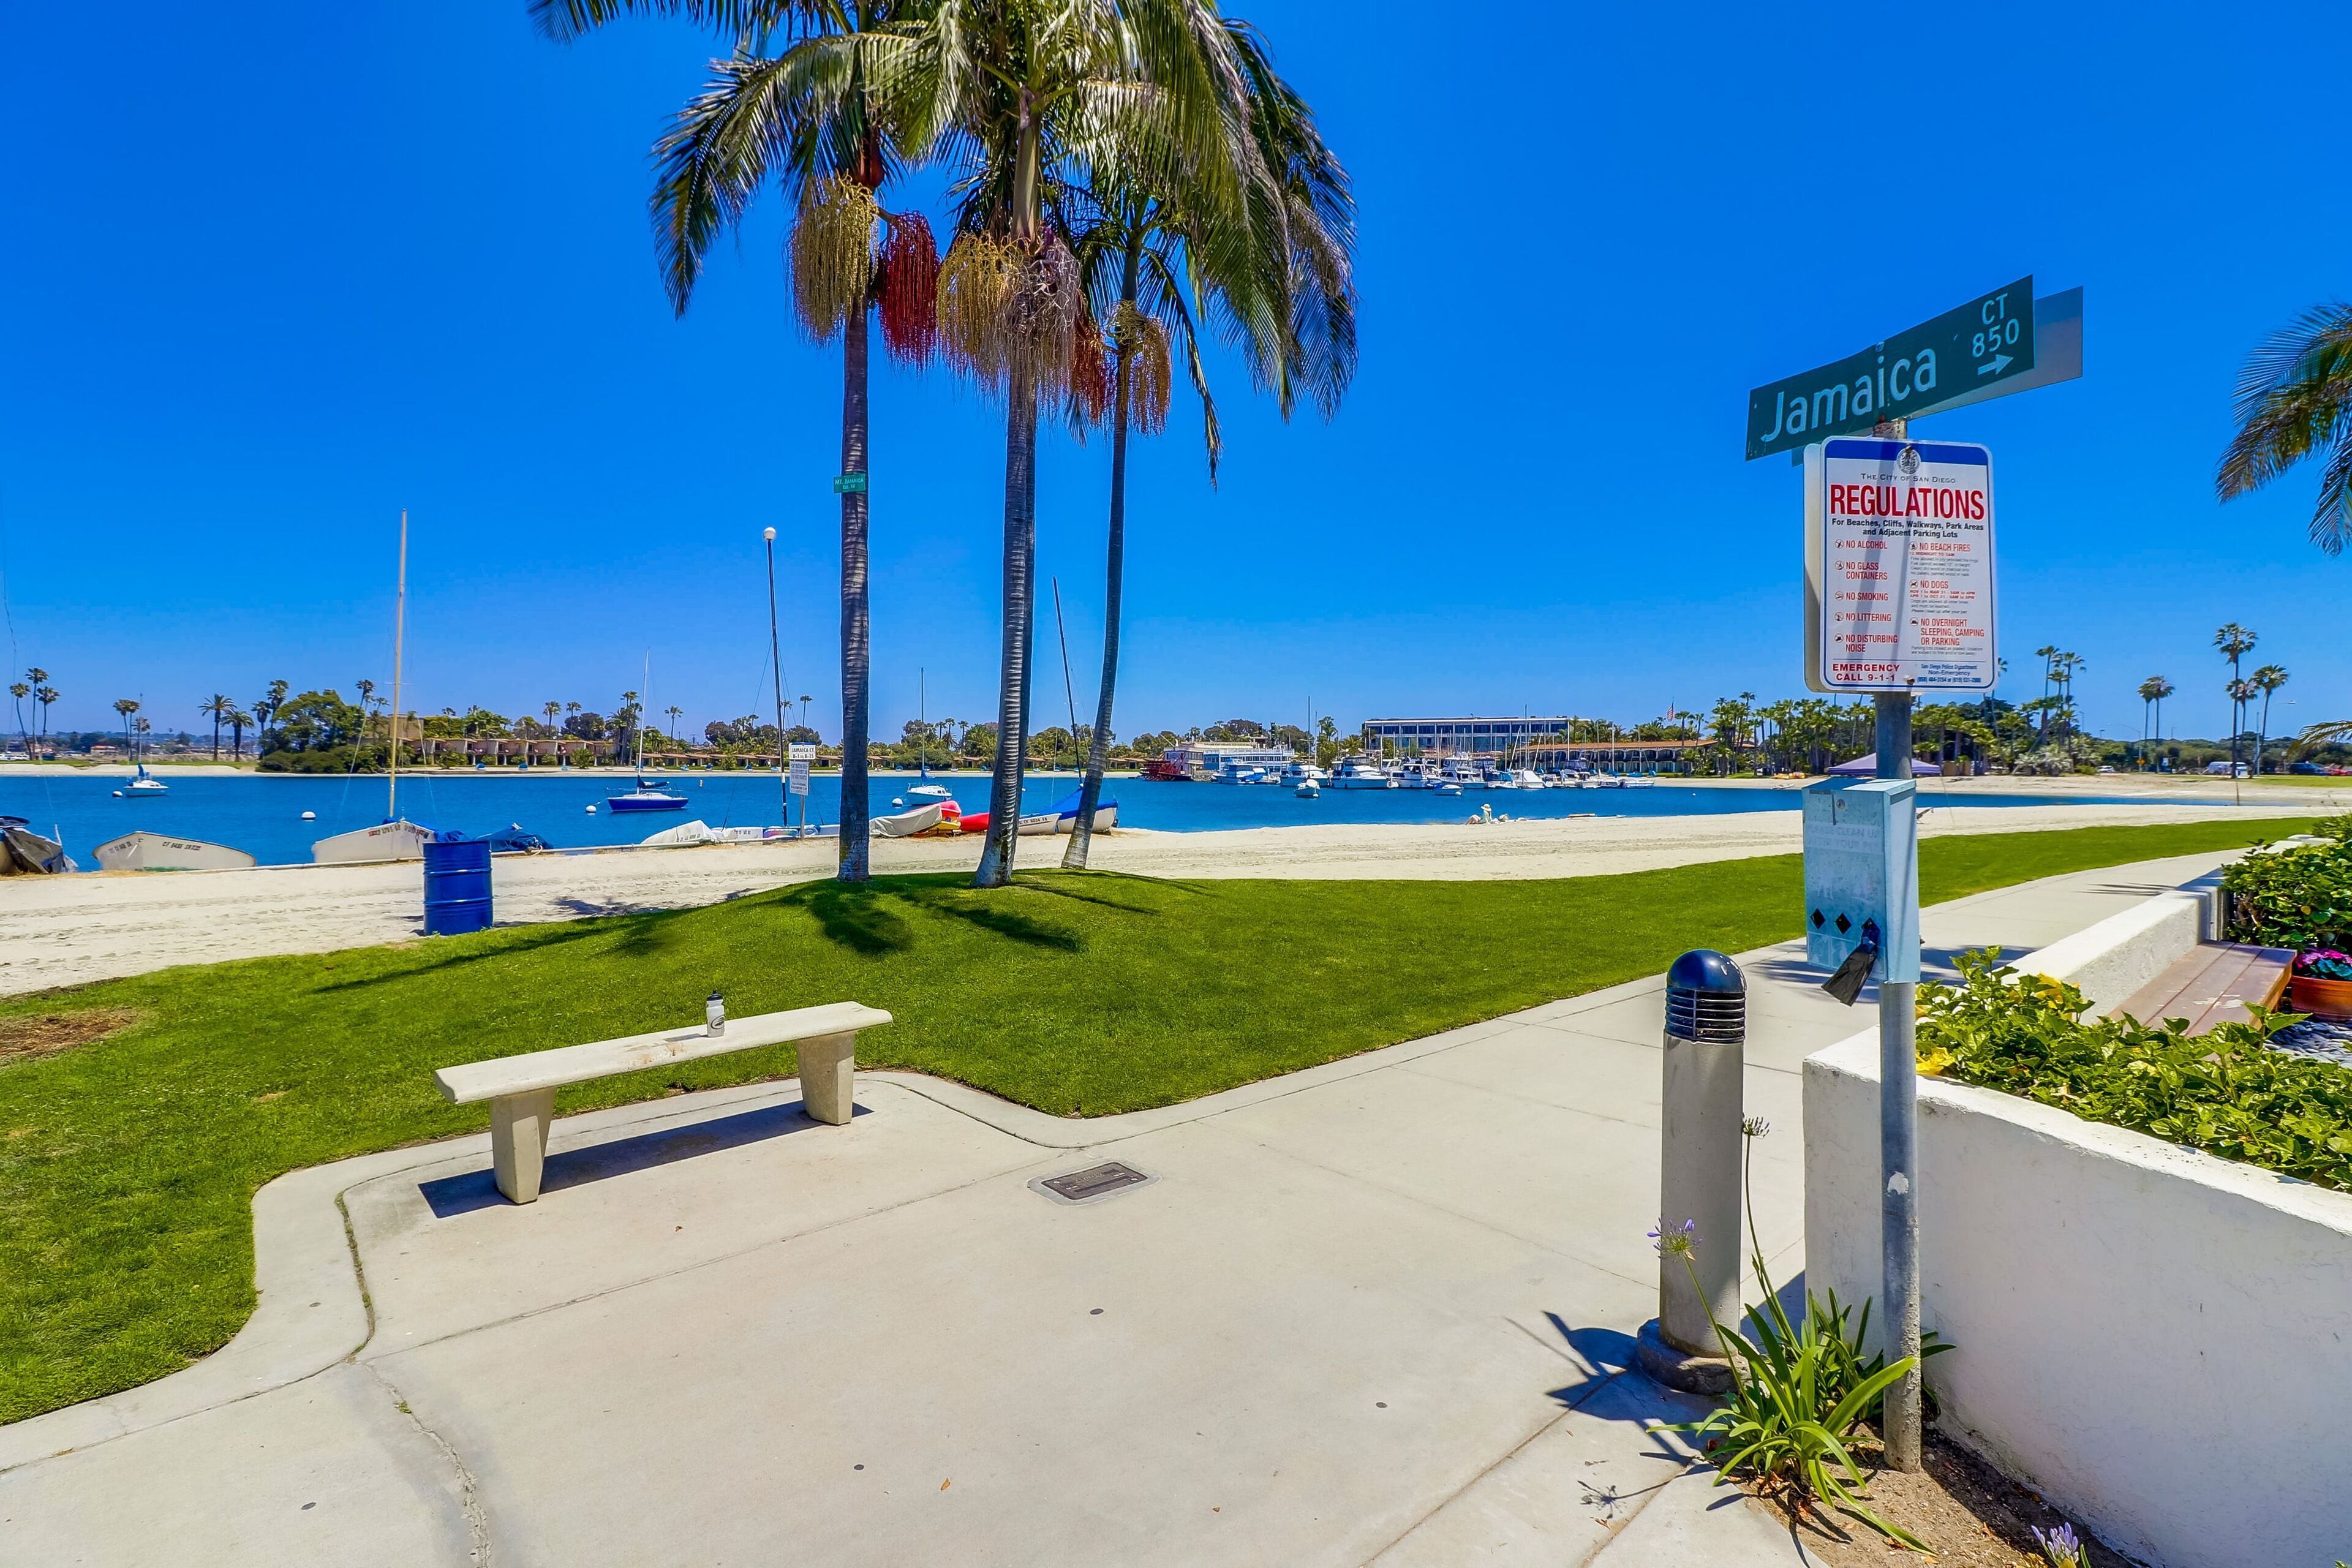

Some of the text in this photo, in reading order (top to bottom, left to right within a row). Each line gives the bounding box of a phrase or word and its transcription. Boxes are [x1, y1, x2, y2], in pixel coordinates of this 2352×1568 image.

[1982, 293, 2008, 325] CT
[1760, 318, 2019, 443] Jamaica 850
[1831, 484, 1985, 520] REGULATIONS
[1847, 519, 1880, 528] Beaches,
[1883, 520, 1904, 528] Cliffs,
[1906, 521, 1943, 530] Walkways,
[1879, 529, 1911, 537] Adjacent
[1913, 530, 1940, 539] Parking
[1857, 541, 1888, 549] ALCOHOL
[1858, 562, 1879, 570] GLASS
[1846, 571, 1888, 580] CONTAINERS
[1858, 613, 1892, 622] LITTERING
[1921, 628, 1984, 637] SLEEPING, CAMPING
[1858, 635, 1898, 643] DISTURBING
